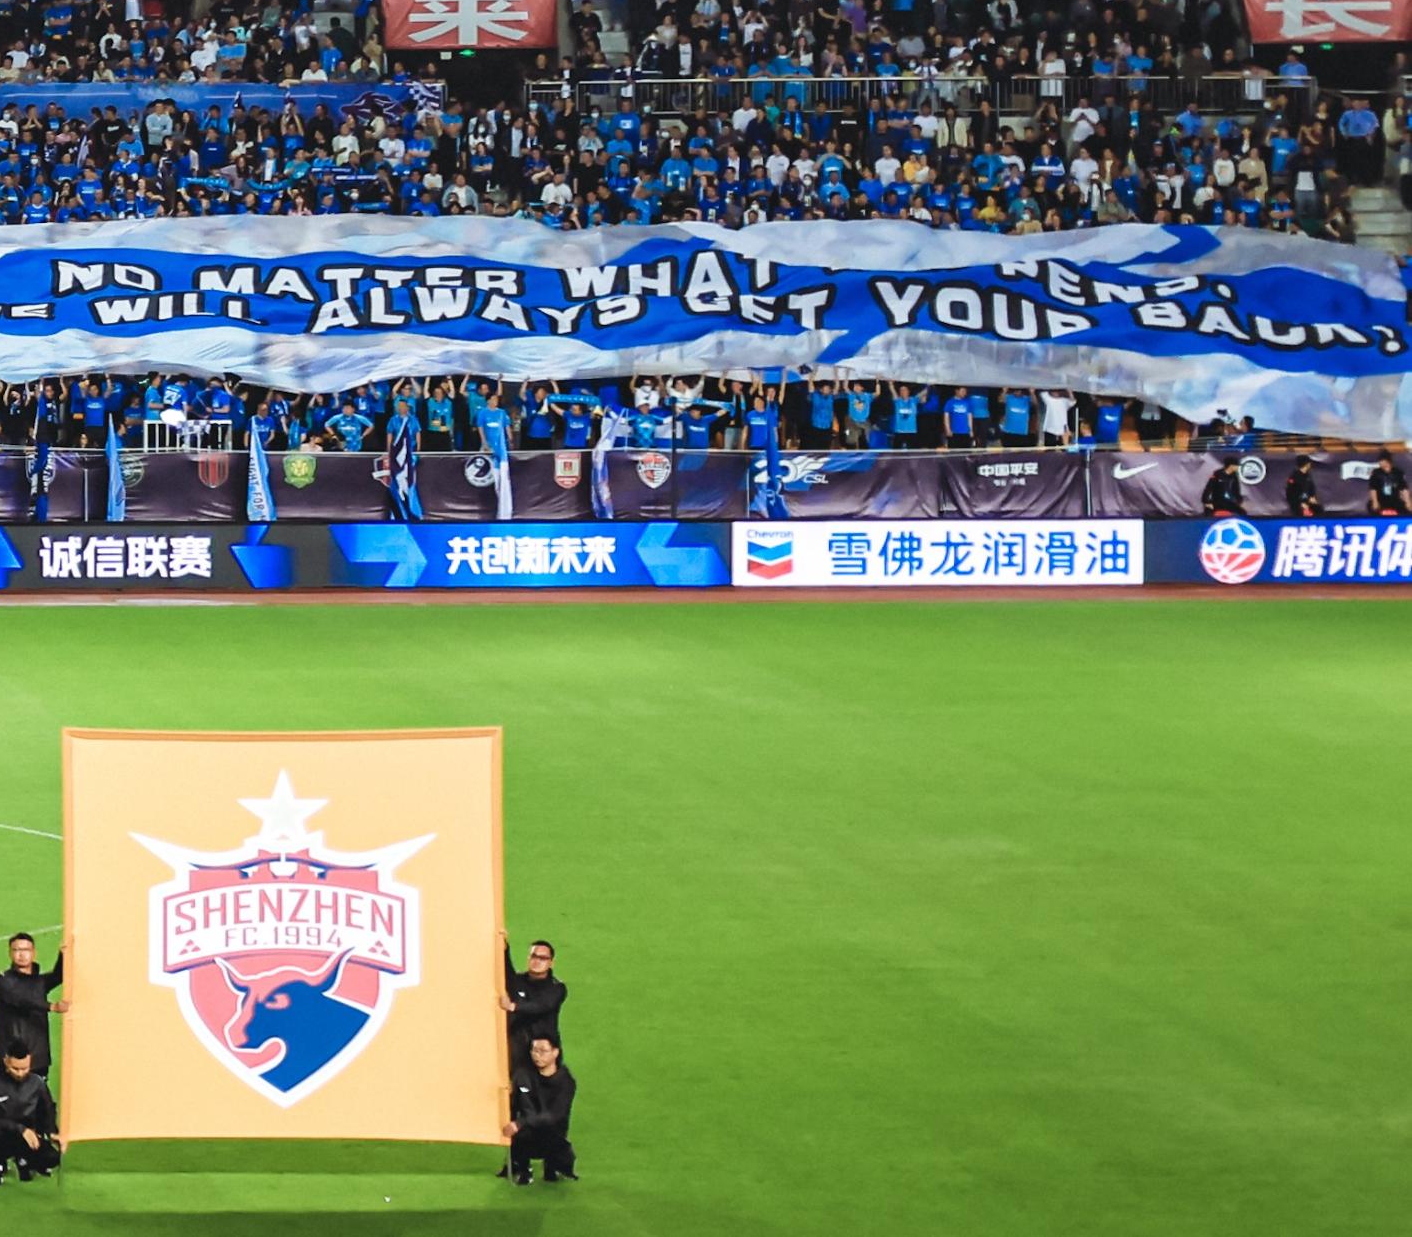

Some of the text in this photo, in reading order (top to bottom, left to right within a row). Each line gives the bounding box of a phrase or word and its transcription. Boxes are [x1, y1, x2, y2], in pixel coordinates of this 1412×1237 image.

[54, 259, 159, 295] NO
[197, 265, 520, 300] MATTER
[94, 292, 267, 325] WILL
[310, 285, 643, 334] ALWAYS
[445, 535, 617, 575] 共创新未来
[746, 529, 794, 539] Chevron
[828, 531, 1131, 577] 雪佛龙润滑油
[39, 536, 212, 579] 诚信联赛
[174, 888, 394, 936] SHENZHEN
